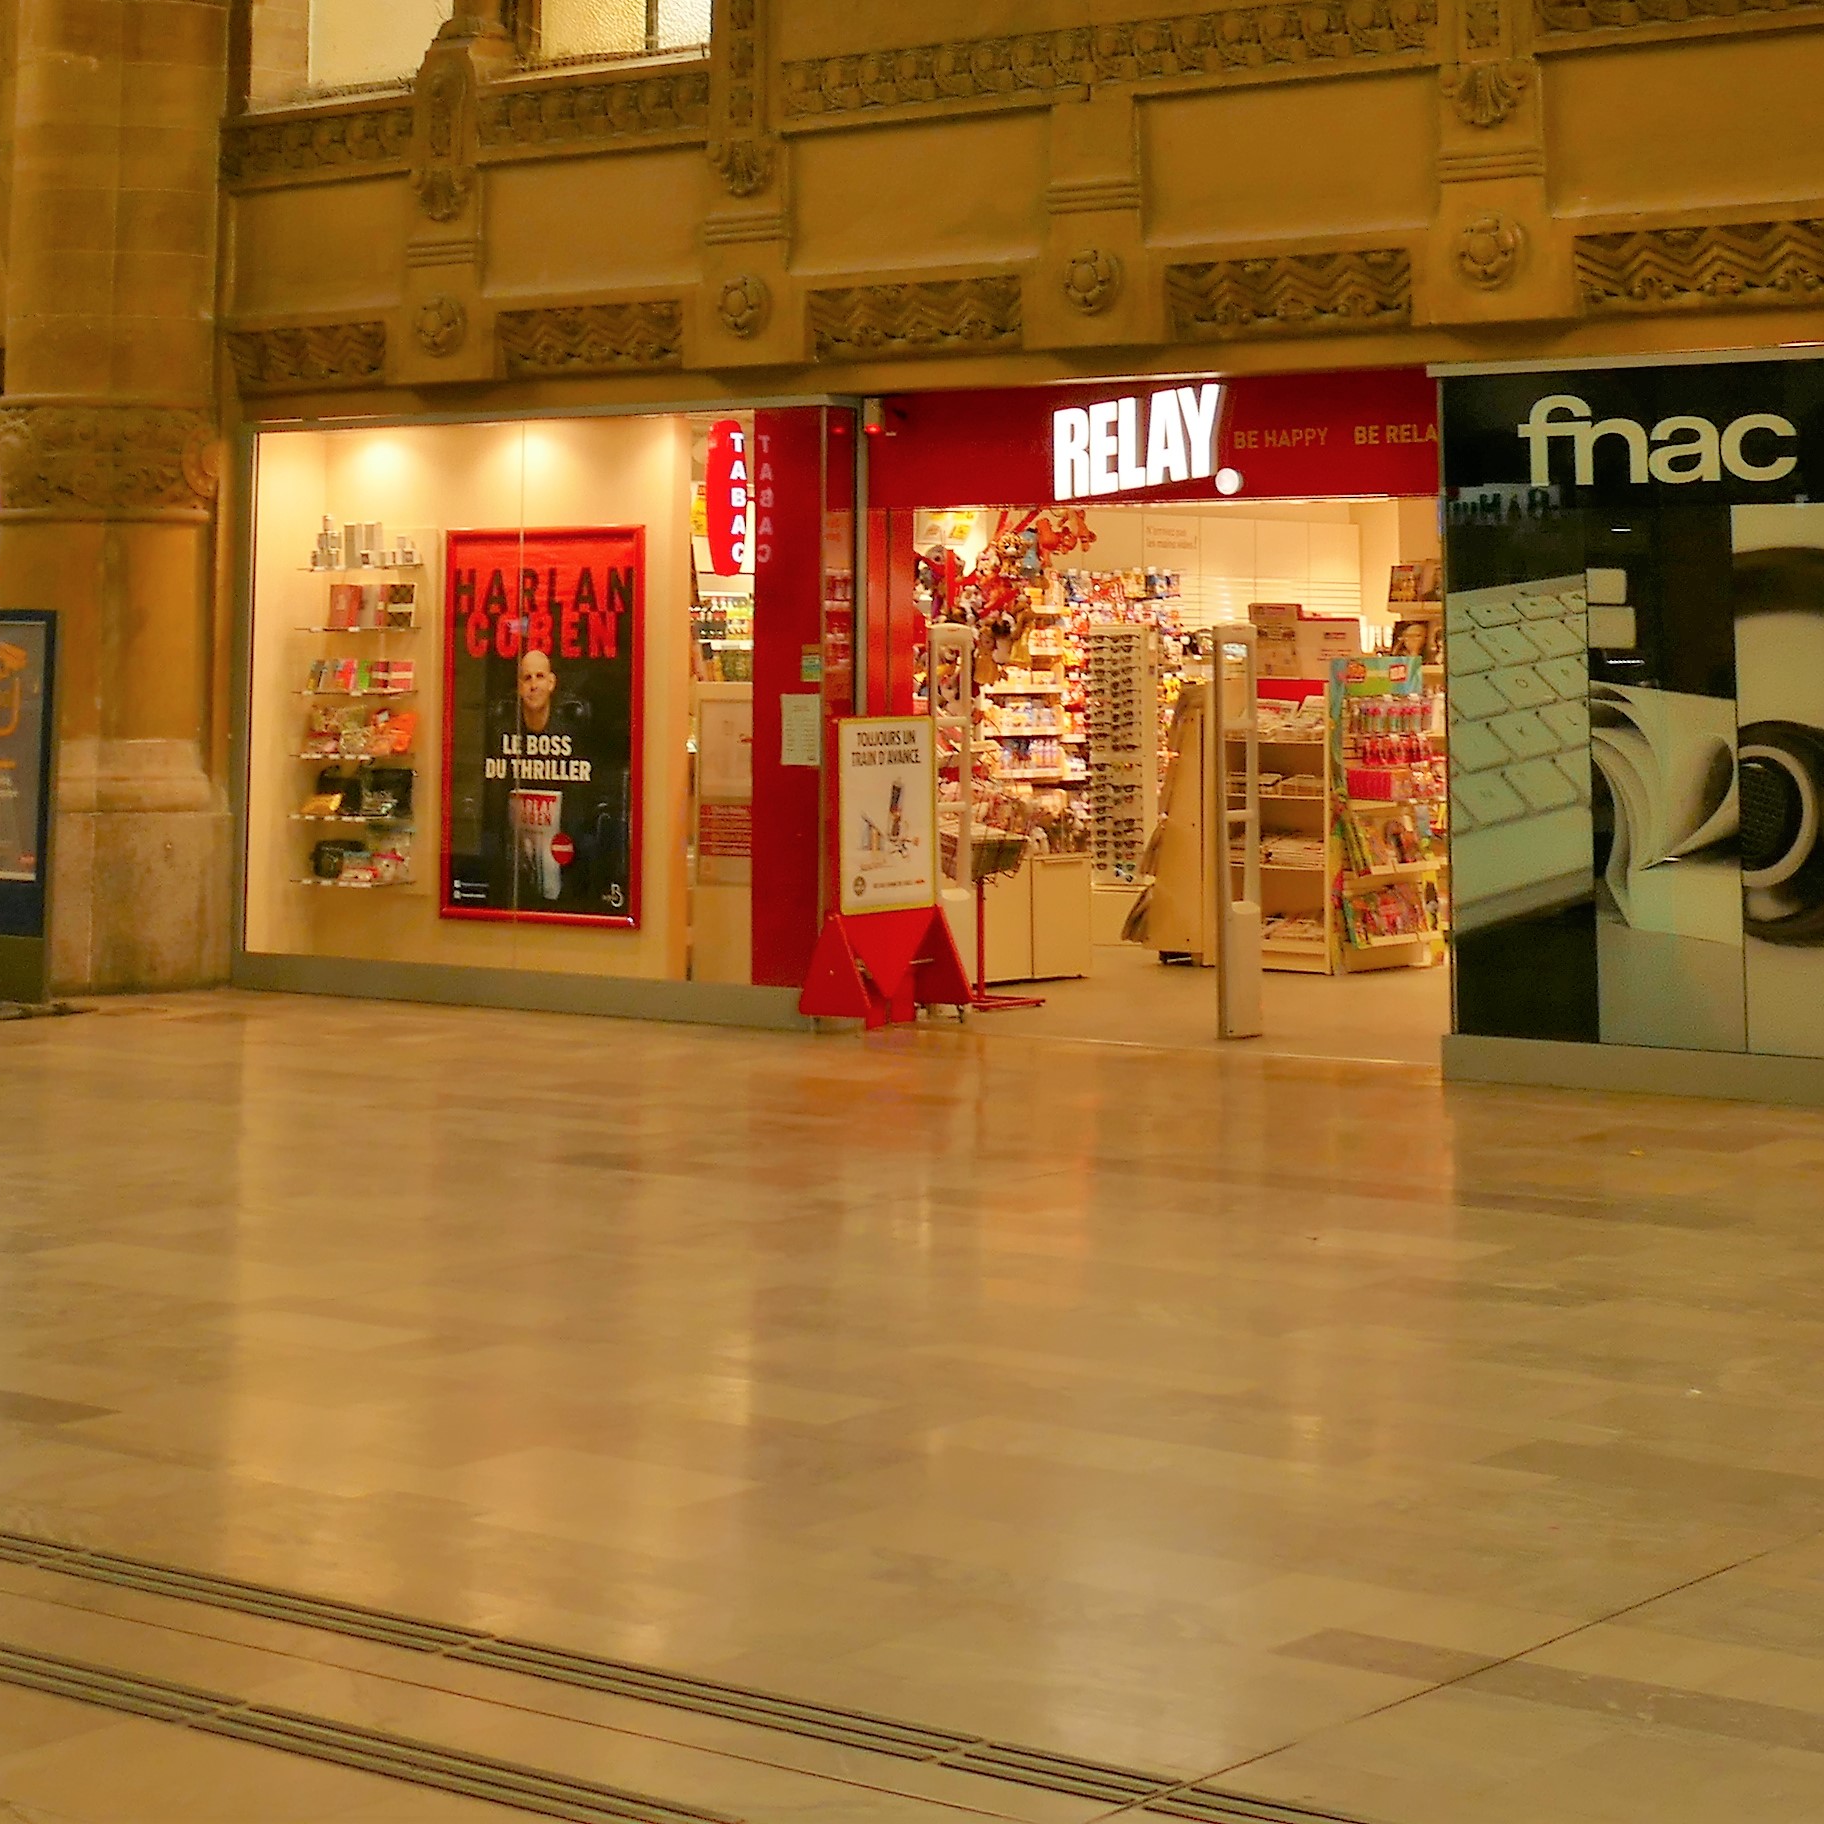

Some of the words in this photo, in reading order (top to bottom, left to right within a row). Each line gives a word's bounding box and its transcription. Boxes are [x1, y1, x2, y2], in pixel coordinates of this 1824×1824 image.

[1233, 430, 1259, 449] BE
[1264, 427, 1328, 448] HAPPY
[1354, 425, 1380, 445] BE
[1517, 394, 1798, 487] fnac
[729, 432, 747, 563] TABAC
[455, 566, 634, 613] HARLAN
[465, 610, 618, 659] COBEN
[502, 733, 522, 756] LE
[526, 734, 573, 757] BOSS
[856, 730, 901, 748] TOUJOURS
[903, 729, 917, 746] UN
[485, 757, 507, 780] DU
[511, 758, 592, 783] THRILLER
[851, 750, 876, 767] TRAIN
